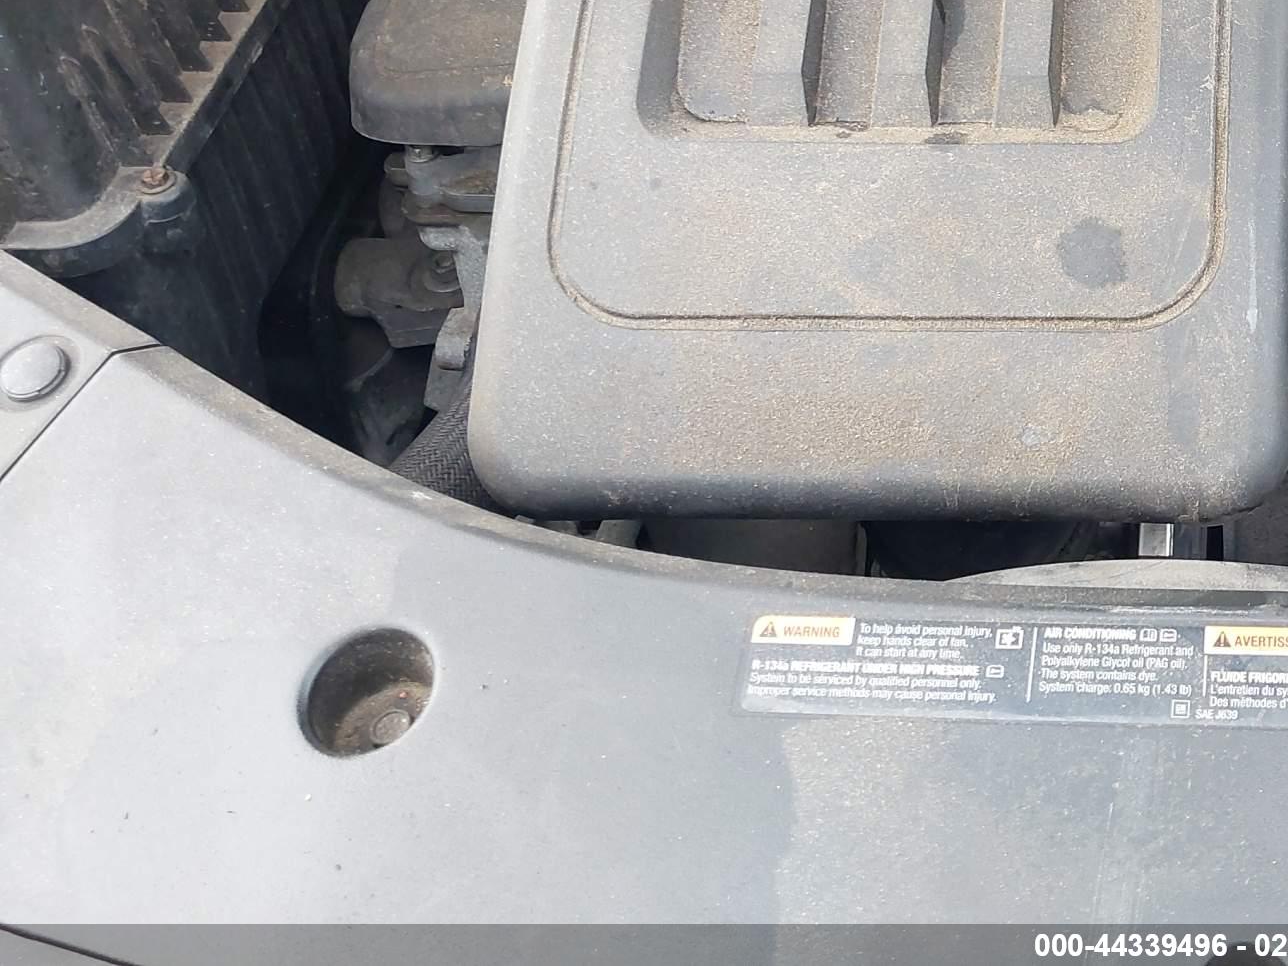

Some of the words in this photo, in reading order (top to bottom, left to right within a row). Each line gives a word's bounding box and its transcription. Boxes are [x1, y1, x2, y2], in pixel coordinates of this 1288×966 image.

[783, 626, 840, 638] WARNING
[861, 624, 871, 634] To
[873, 624, 893, 636] help
[895, 625, 921, 635] avoid
[922, 625, 963, 637] personal
[1043, 627, 1063, 638] AIR
[1064, 627, 1136, 640] CONDITIONING
[857, 635, 881, 646] keep
[883, 635, 912, 645] hands
[913, 636, 937, 646] clear
[939, 637, 948, 647] of
[856, 646, 863, 655] It
[865, 648, 882, 656] can
[884, 647, 907, 657] start
[909, 648, 918, 657] at
[919, 649, 938, 660] any
[1043, 643, 1061, 653] Use
[1062, 643, 1082, 655] only
[1084, 643, 1120, 654] R-134a
[1121, 645, 1174, 657] Refrigerant
[1175, 645, 1194, 656] and
[790, 660, 861, 673] REFRIGERANT
[862, 662, 898, 674] UNDER
[899, 663, 925, 675] HIGH
[926, 664, 980, 676] PRESSURE
[1041, 655, 1100, 668] Polyalkylene
[1101, 656, 1130, 669] Glycol
[1131, 657, 1144, 668] oil
[1146, 657, 1168, 670] (PAG
[750, 672, 785, 685] System
[787, 673, 797, 683] to
[799, 673, 812, 684] be
[814, 674, 853, 685] serviced
[855, 676, 867, 687] by
[869, 676, 910, 688] qualified
[911, 677, 958, 689] personnel
[1041, 667, 1058, 679] The
[1060, 669, 1094, 682] system
[1096, 669, 1136, 681] contains
[1210, 671, 1247, 683] FLUIDE
[748, 685, 791, 698] Improper
[792, 687, 828, 698] service
[829, 687, 871, 699] methods
[872, 690, 893, 701] may
[895, 690, 923, 700] cause
[925, 691, 966, 702] personal
[1039, 681, 1074, 693] System
[1076, 682, 1112, 696] charge:
[1113, 683, 1136, 694] 0.65
[1138, 684, 1150, 696] kg
[1152, 684, 1177, 696] (1.43
[1179, 684, 1192, 697] lb)
[1210, 684, 1259, 695] L'entretien
[1262, 685, 1275, 695] du
[1210, 695, 1228, 707] Des
[1230, 696, 1278, 708] méthodes
[1195, 708, 1215, 719] SAE
[1216, 709, 1238, 720] J639
